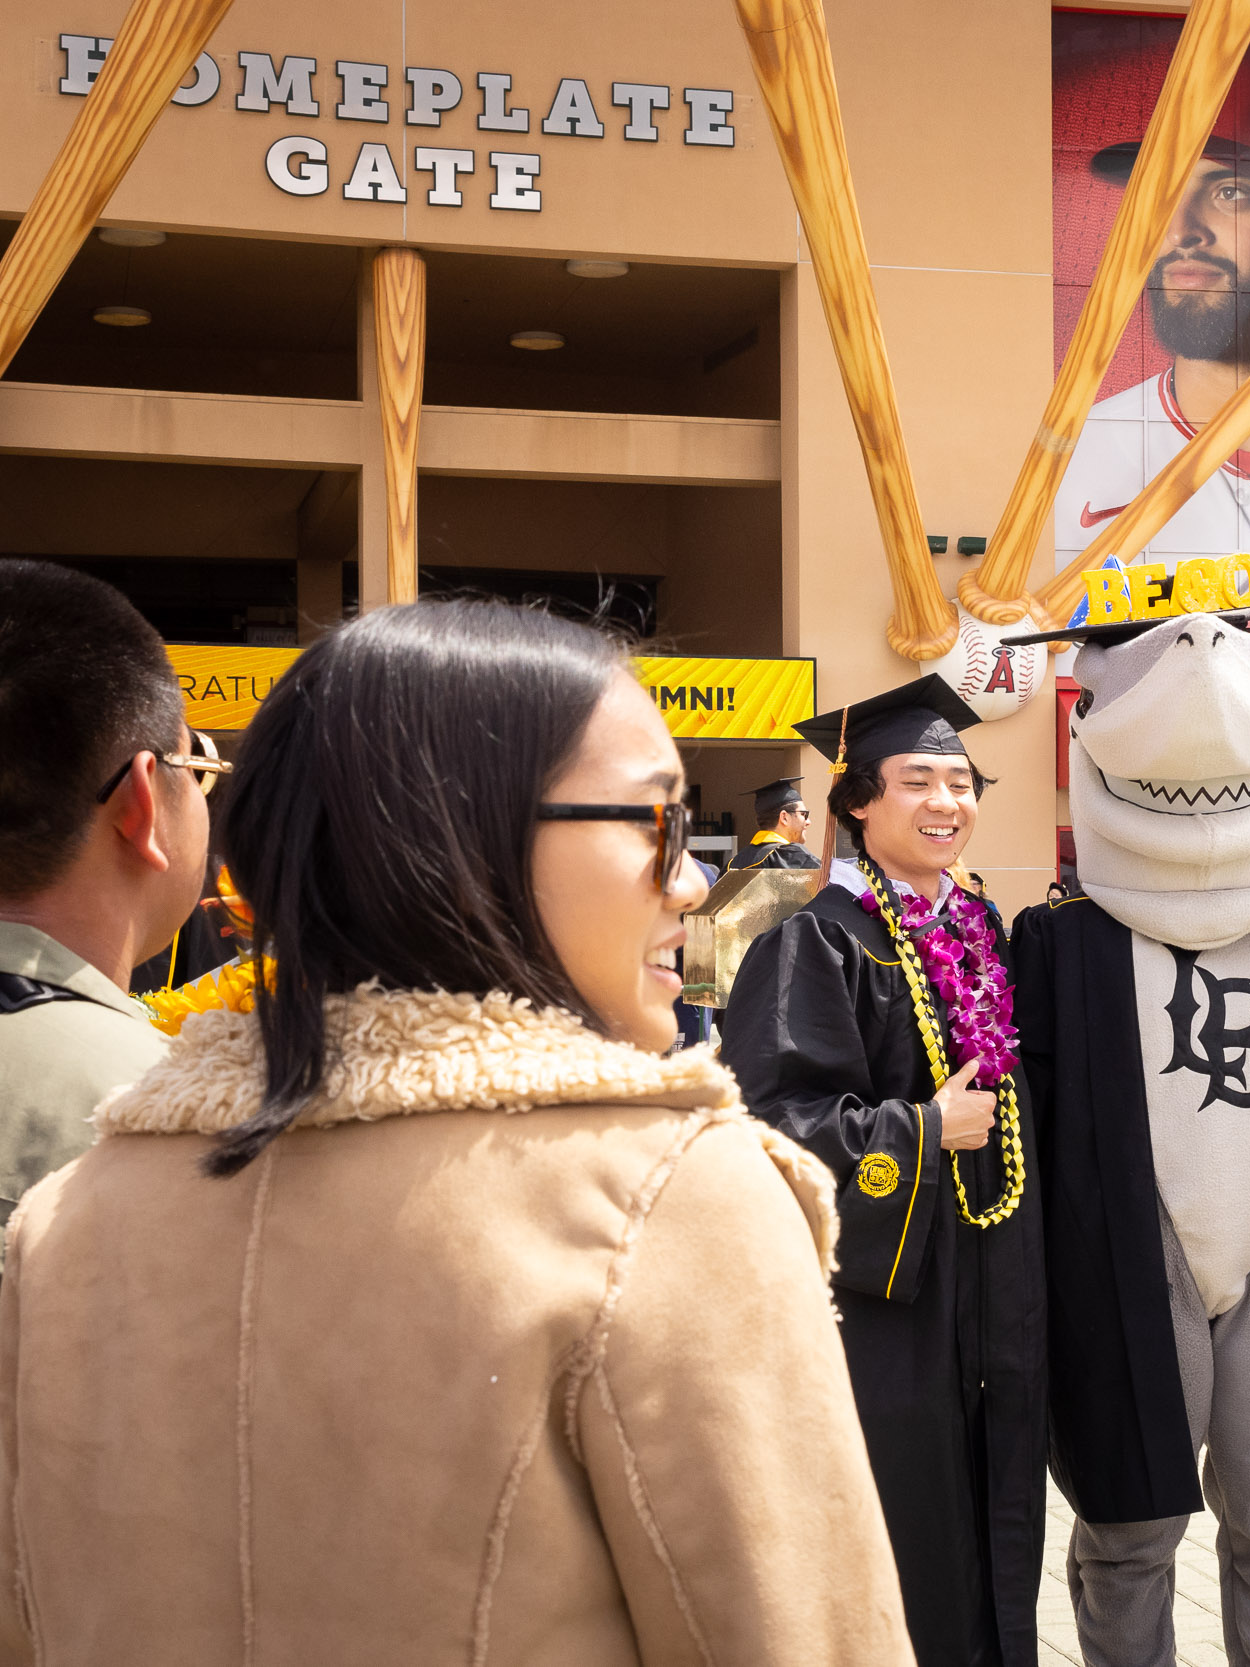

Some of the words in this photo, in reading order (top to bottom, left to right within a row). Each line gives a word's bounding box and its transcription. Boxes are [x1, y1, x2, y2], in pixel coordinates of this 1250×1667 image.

[59, 33, 735, 147] HOMEPLATE
[265, 135, 541, 212] GATE
[651, 685, 735, 711] MNI!
